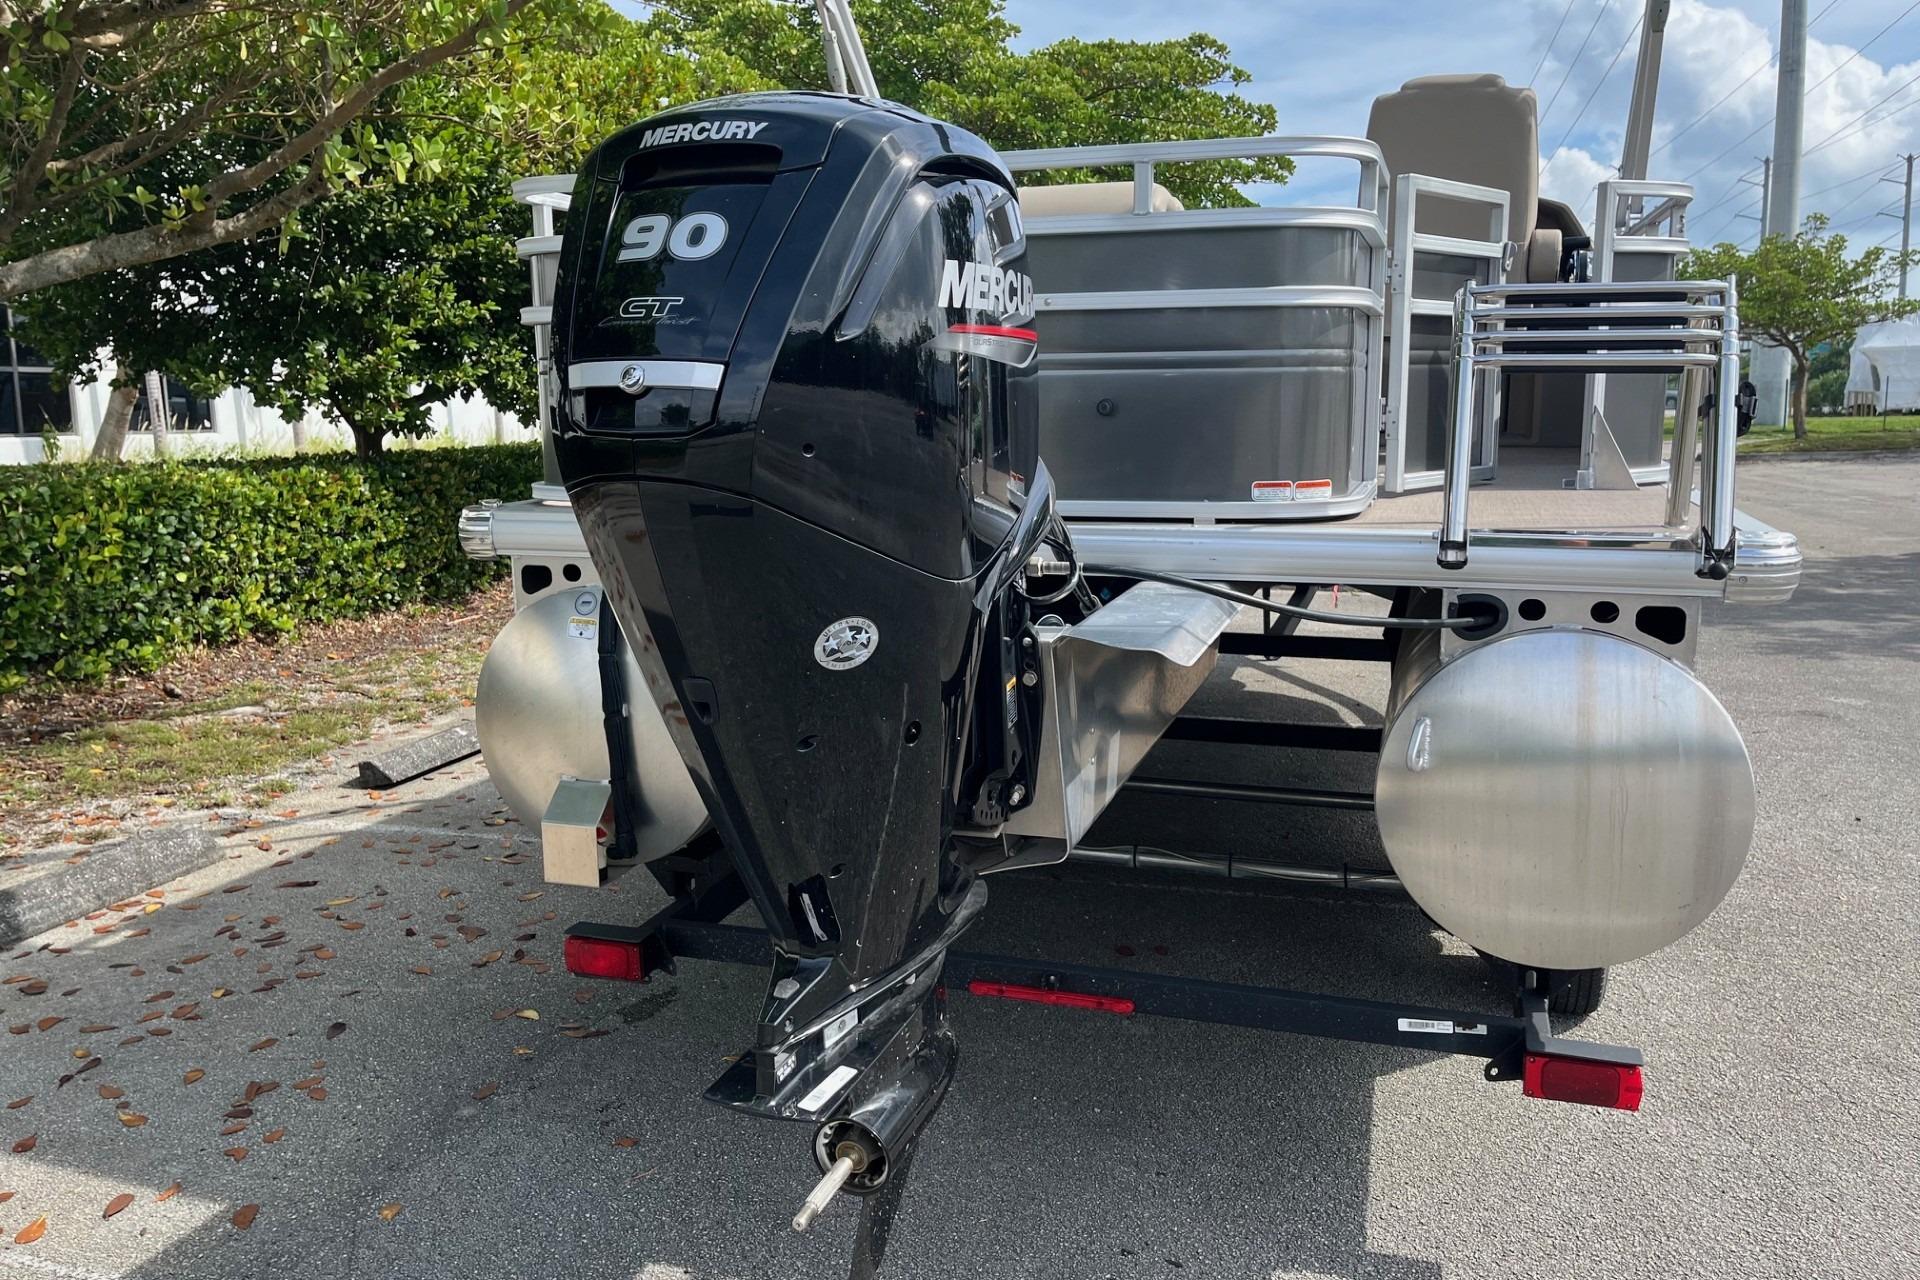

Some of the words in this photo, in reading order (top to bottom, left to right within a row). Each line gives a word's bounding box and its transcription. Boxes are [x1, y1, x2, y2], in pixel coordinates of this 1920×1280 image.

[639, 121, 769, 149] MERCURY
[616, 211, 729, 264] 90
[620, 296, 684, 318] GT
[938, 259, 1035, 318] MERCUR
